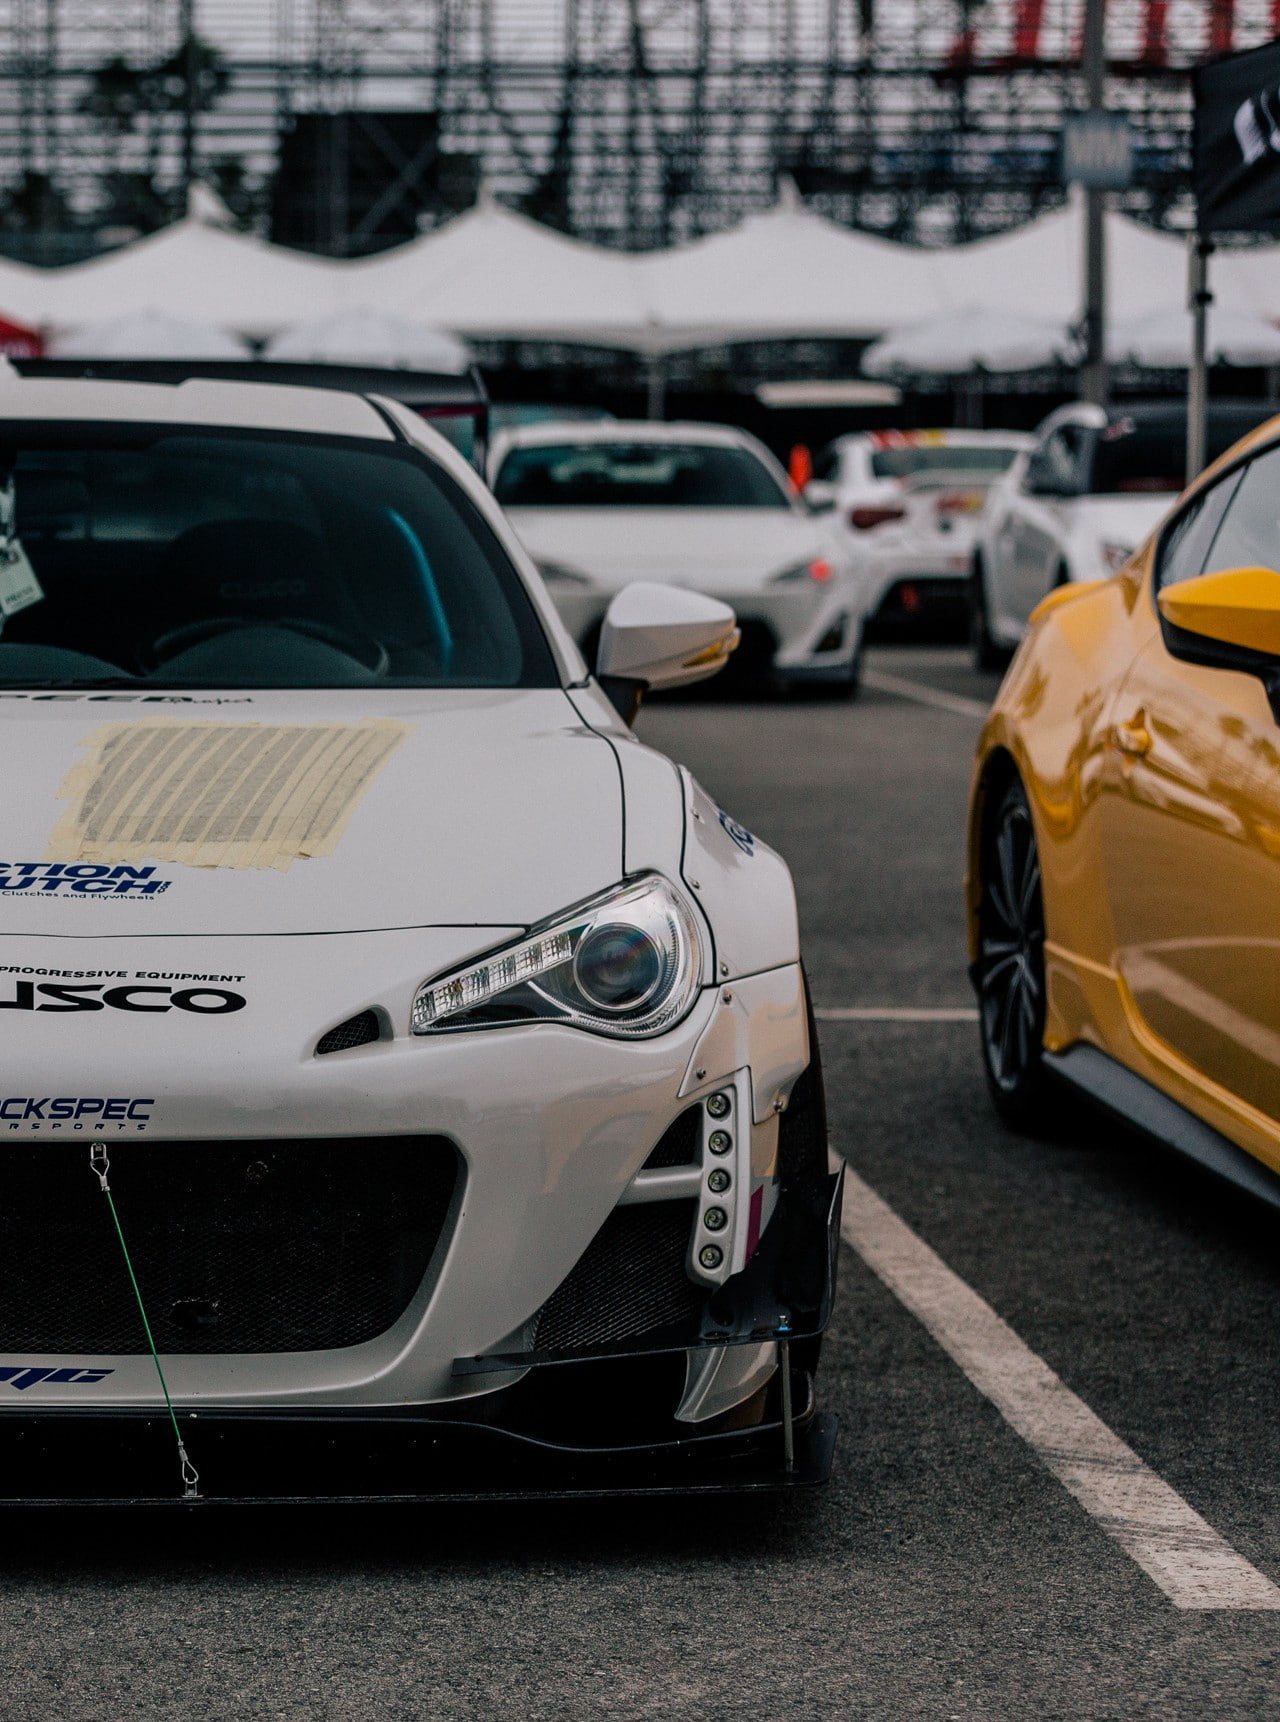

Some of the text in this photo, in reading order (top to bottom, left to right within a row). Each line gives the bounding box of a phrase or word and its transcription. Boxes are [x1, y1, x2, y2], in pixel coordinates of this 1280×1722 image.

[2, 890, 59, 898] Clutches
[90, 892, 155, 901] Flywheels
[135, 972, 246, 982] EQUIPMENT
